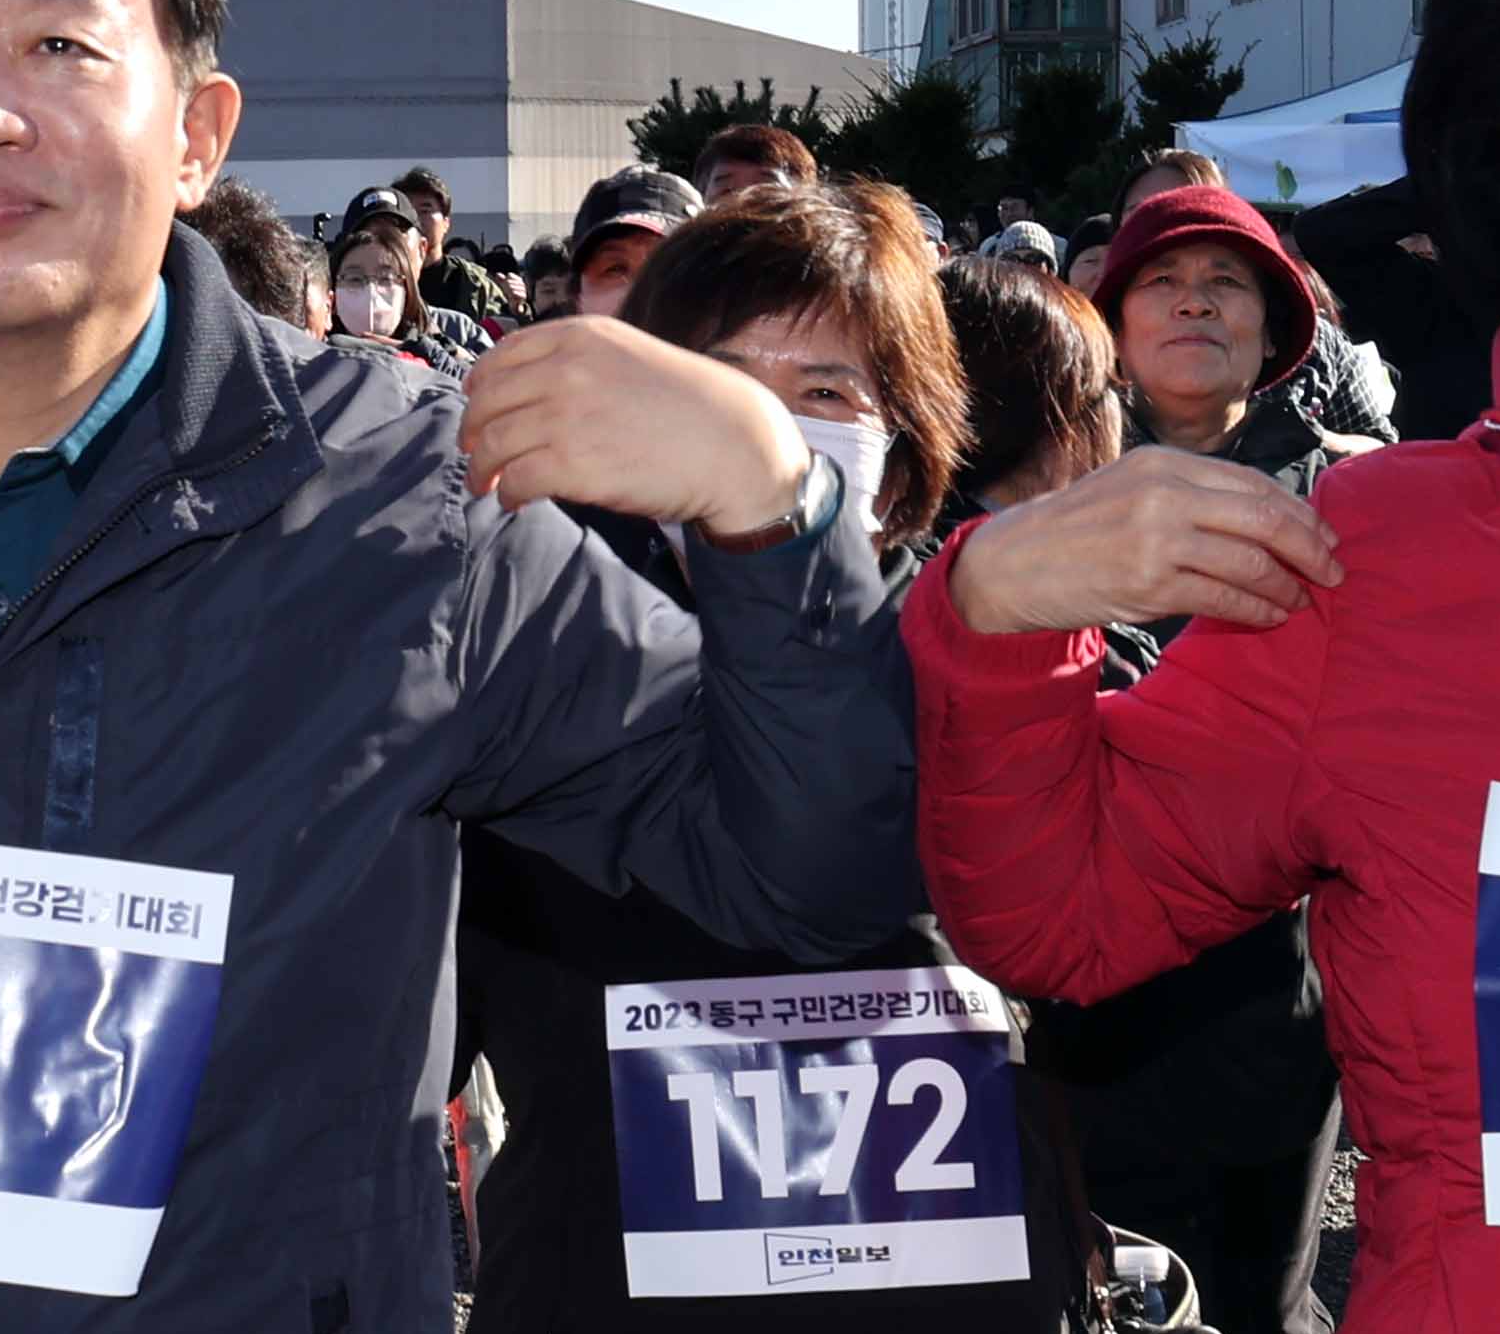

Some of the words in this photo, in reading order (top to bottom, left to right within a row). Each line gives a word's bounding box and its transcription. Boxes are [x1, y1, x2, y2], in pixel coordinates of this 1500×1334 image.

[624, 1001, 703, 1031] 2023
[709, 998, 766, 1028] 동구
[772, 989, 989, 1025] 구민건강걷기대회
[667, 1056, 976, 1203] 1172
[776, 1244, 892, 1267] 인천일보
